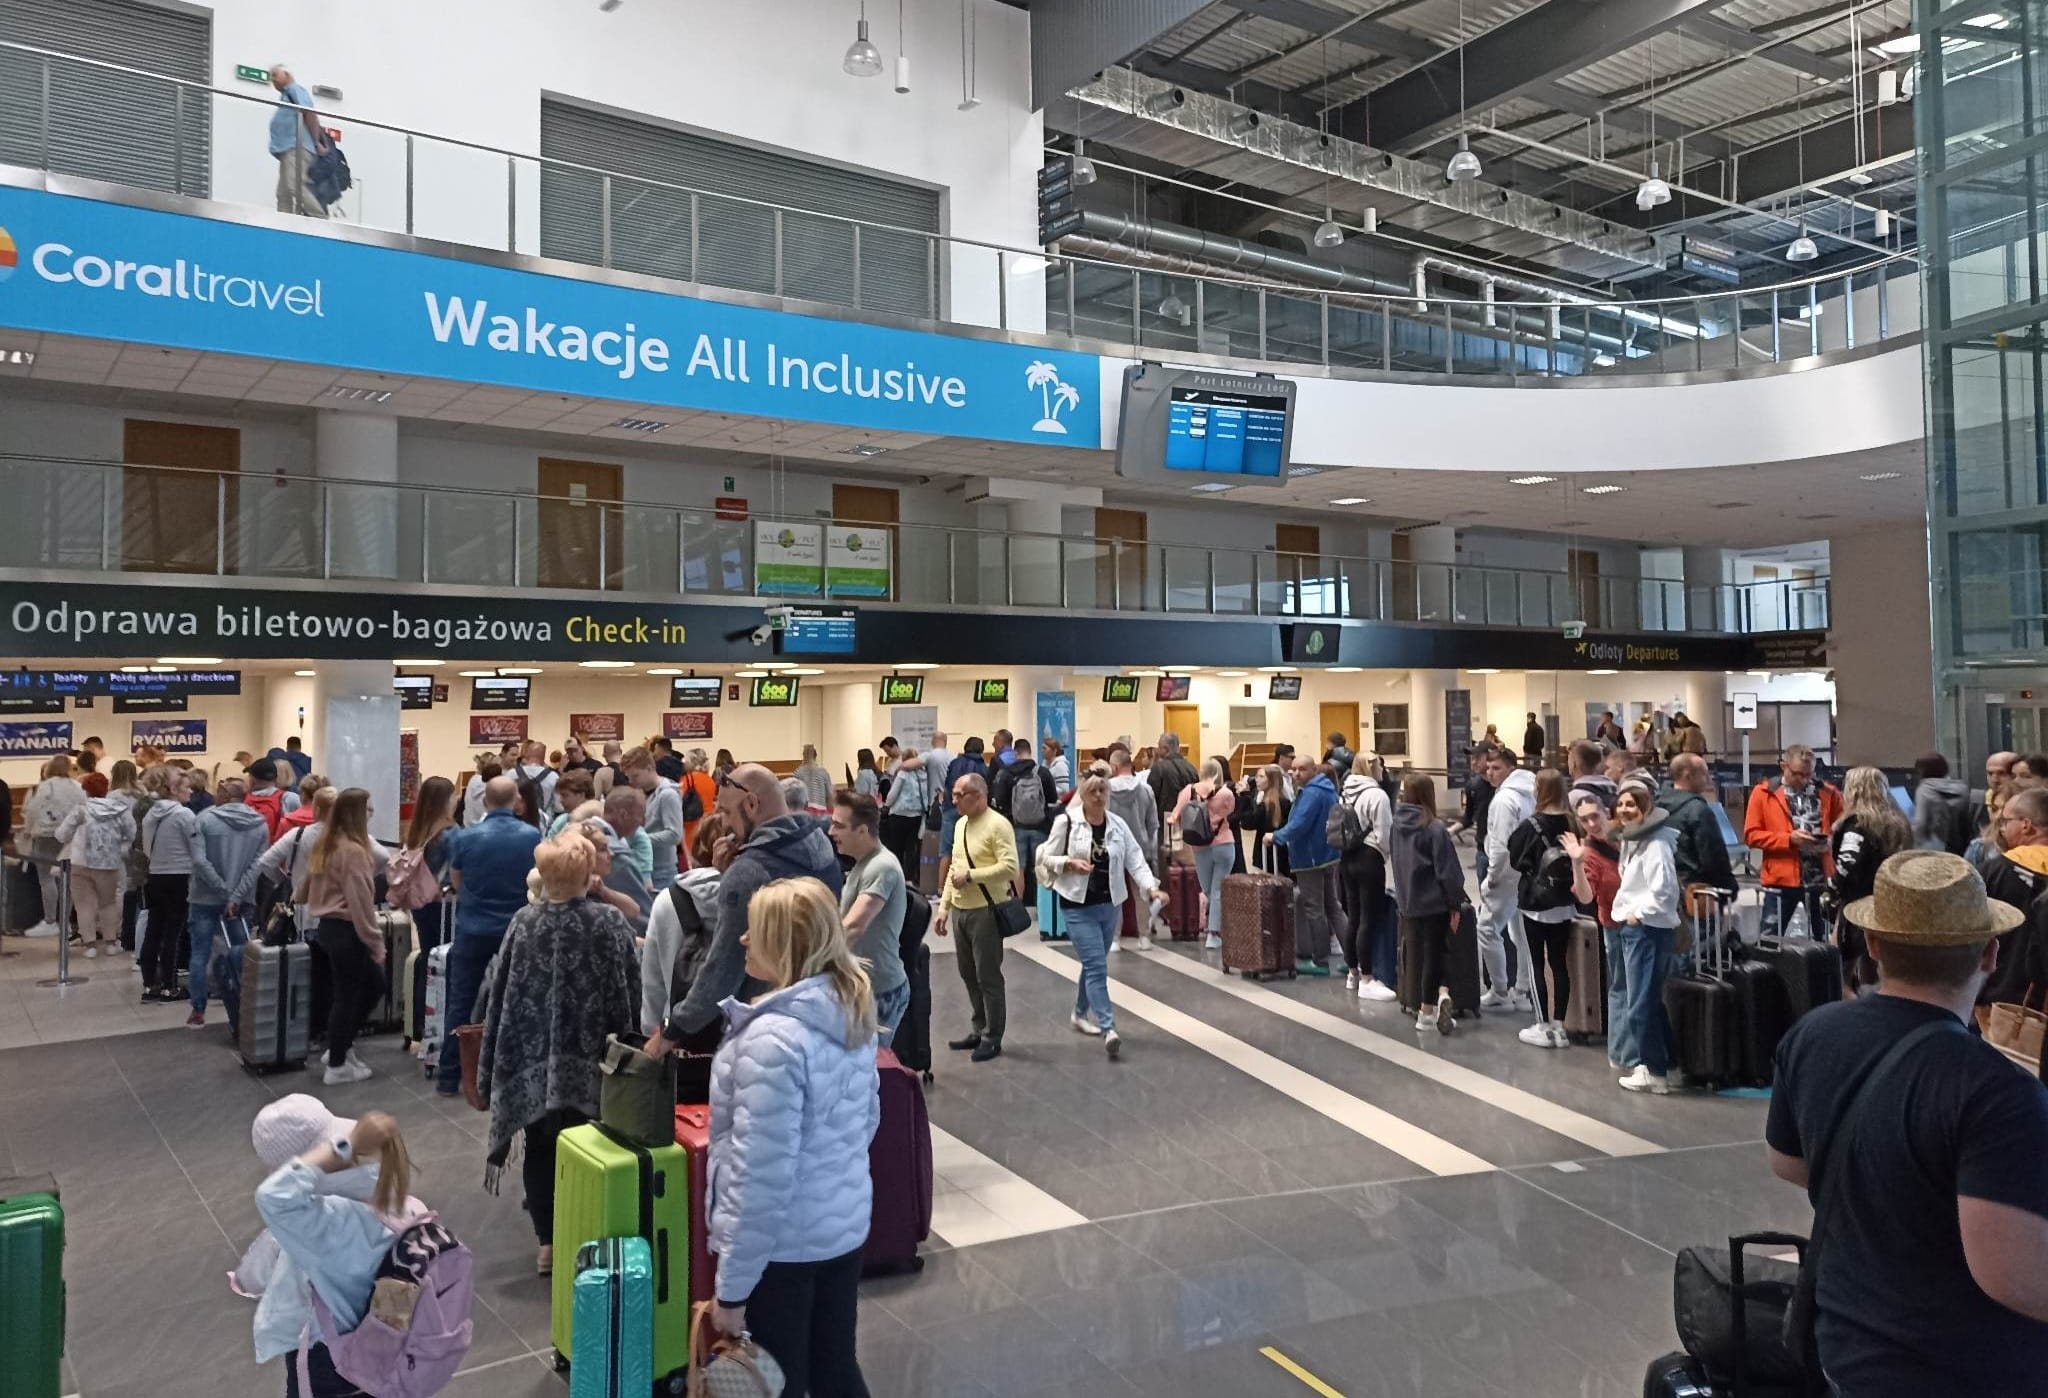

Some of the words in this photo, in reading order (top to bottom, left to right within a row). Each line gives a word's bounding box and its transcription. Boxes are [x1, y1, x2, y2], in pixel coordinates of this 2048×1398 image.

[424, 291, 670, 379] Wakacje
[686, 334, 750, 383] All
[767, 343, 968, 408] Inclusive
[1194, 375, 1216, 386] Port
[1221, 378, 1262, 393] Lotniczy
[12, 601, 197, 642] Odprawa
[217, 604, 552, 648] biletowo-bagażowa
[566, 616, 687, 644] Check-in
[1589, 642, 1623, 663] Odloty
[1626, 643, 1680, 662] Departures
[54, 673, 89, 684] Toalety
[191, 673, 235, 682] dzieckiem
[133, 735, 203, 747] RYANAIR
